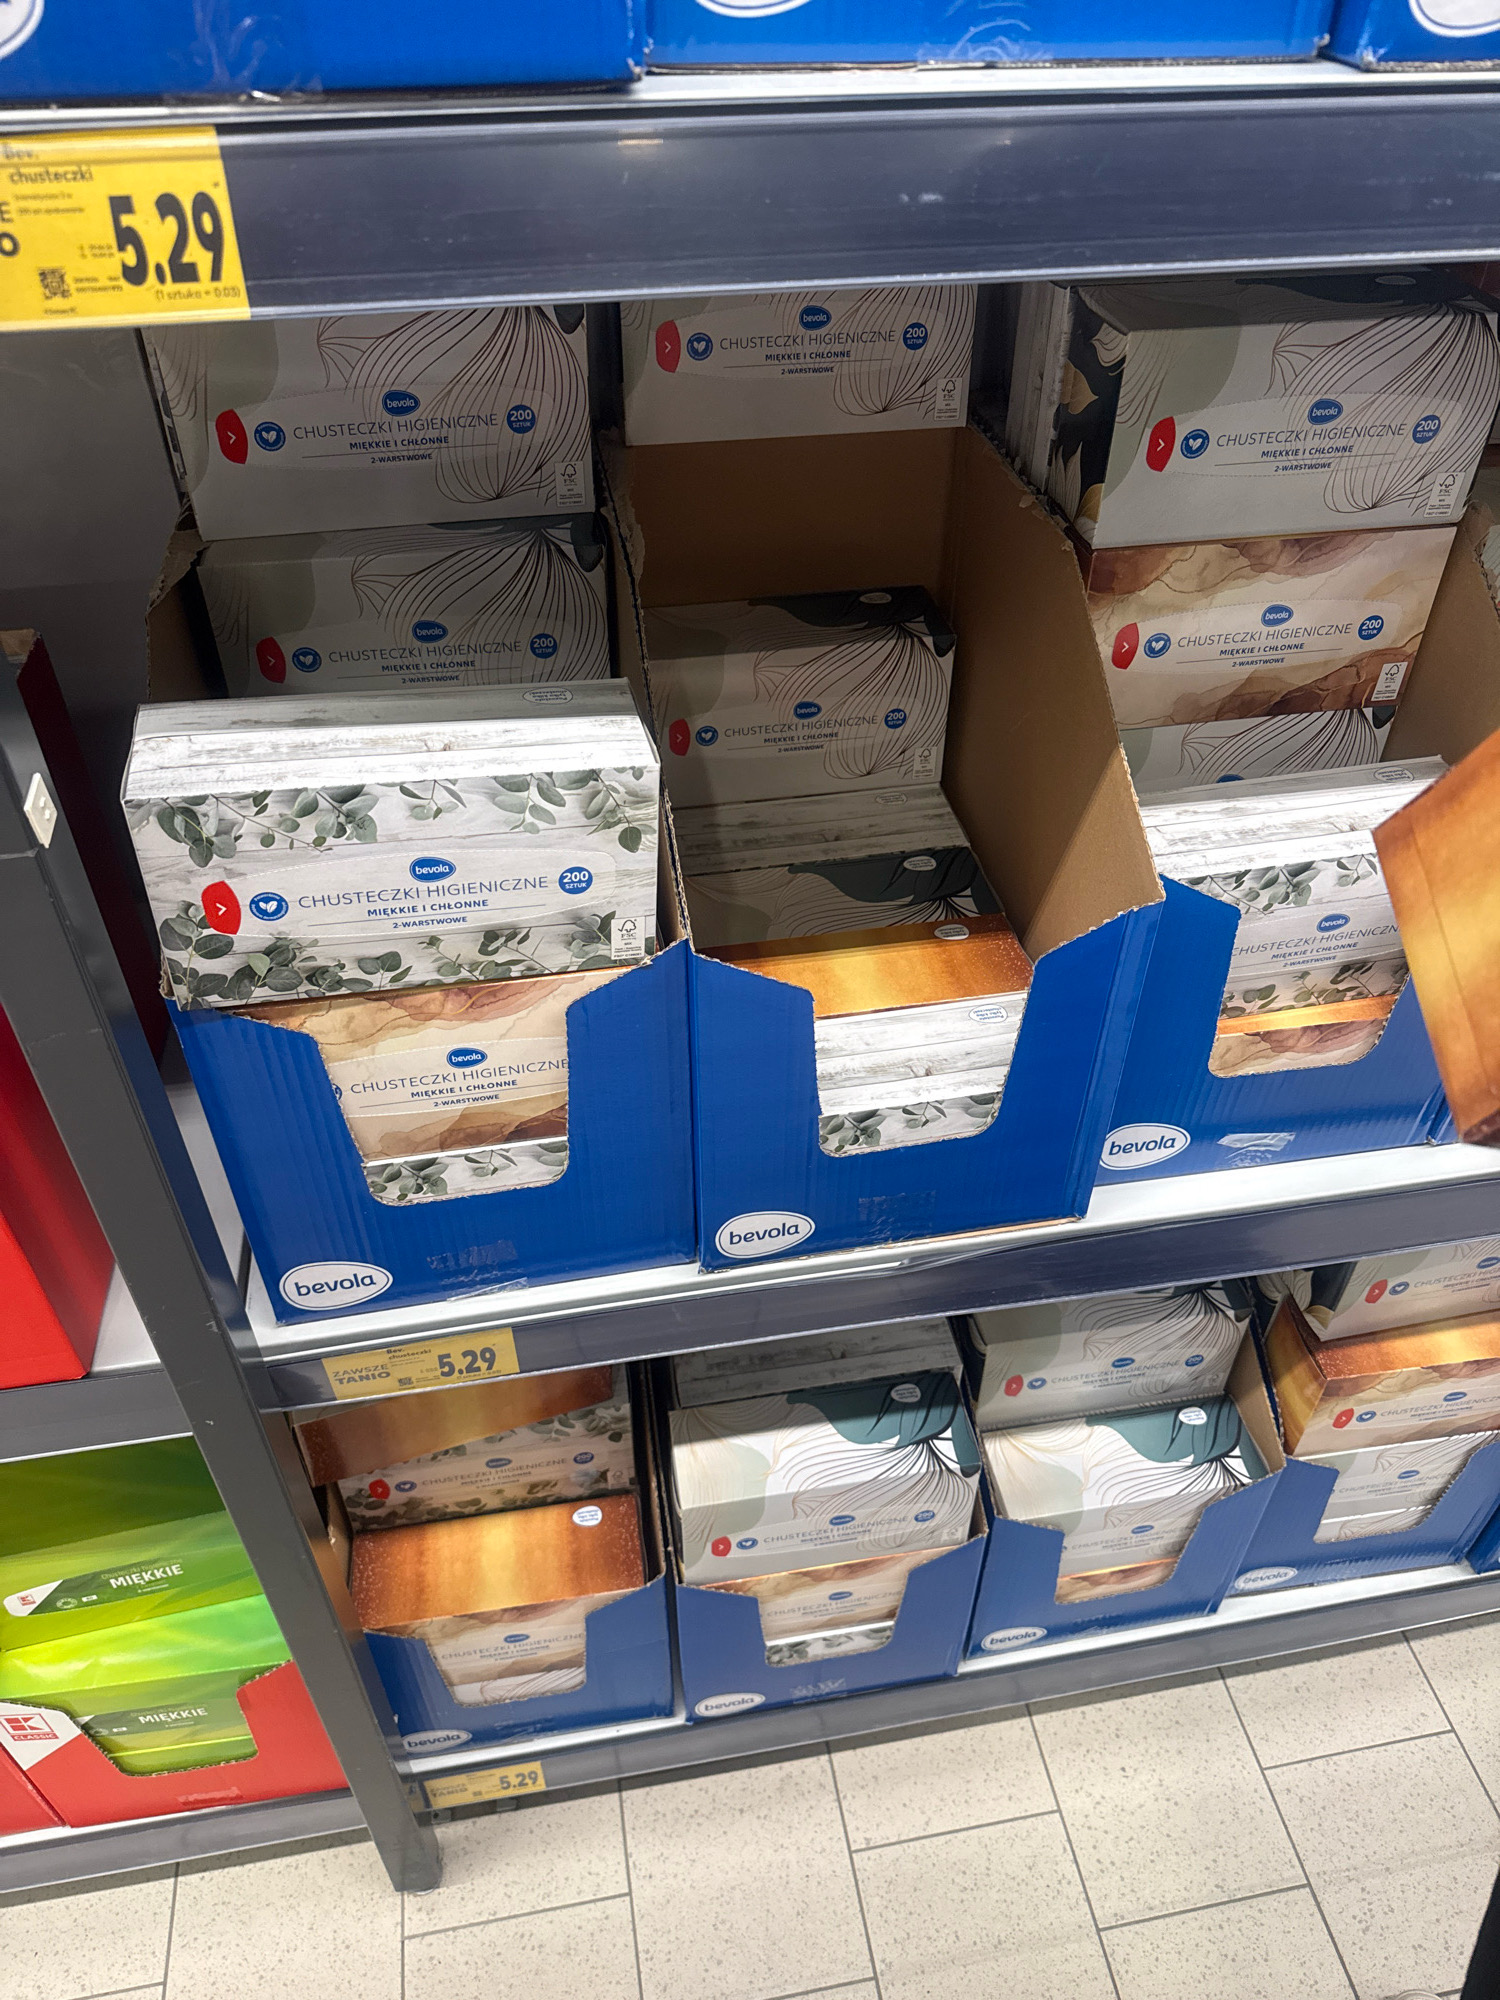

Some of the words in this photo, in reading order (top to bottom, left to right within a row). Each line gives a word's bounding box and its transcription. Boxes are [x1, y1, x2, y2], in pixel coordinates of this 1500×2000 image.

[9, 165, 94, 184] chusteczki
[108, 191, 224, 287] 5.29
[803, 312, 827, 322] bevola
[905, 327, 925, 338] 200
[720, 334, 804, 351] CHUSTECZKI
[808, 330, 896, 345] HIGIENICZNE
[765, 352, 801, 363] MIĘKKIE
[809, 350, 851, 359] CHŁONNE
[780, 366, 834, 375] 2-WARSTWOWE
[386, 398, 416, 408] bevola
[509, 410, 532, 422] 200
[1312, 405, 1339, 417] bevola
[293, 421, 393, 441] CHUSTECZKI
[398, 412, 498, 432] HIGIENICZNE
[512, 421, 531, 429] SZTUK
[1417, 419, 1439, 432] 200
[1216, 429, 1309, 447] CHUSTECZKI
[1312, 423, 1408, 441] HIGIENICZNE
[349, 439, 392, 451] MIĘKKIE
[394, 439, 398, 448] I
[400, 435, 450, 447] CHŁONNE
[370, 453, 433, 464] 2-WARSTWOWE
[1261, 447, 1301, 459] MIĘKKIE
[1308, 445, 1354, 456] CHŁONNE
[1274, 462, 1332, 473] 2-WARSTWOWE
[1264, 609, 1290, 620] bevola
[1361, 618, 1382, 630] 200
[416, 626, 444, 637] bevola
[1177, 630, 1262, 649] CHUSTECZKI
[1266, 622, 1353, 642] HIGIENICZNE
[1361, 629, 1378, 637] SZTUK
[532, 638, 555, 648] 200
[1219, 646, 1255, 658] MIĘKKIE
[1263, 642, 1305, 653] CHŁONNE
[328, 646, 423, 663] CHUSTECZKI
[426, 640, 522, 657] HIGIENICZNE
[381, 662, 422, 673] MIĘKKIE
[430, 659, 476, 670] CHŁONNE
[1231, 657, 1285, 668] 2-WARSTWOWE
[401, 674, 460, 684] 2-WARSTWOWE
[886, 712, 904, 721] 200
[724, 723, 799, 738] CHUSTECZKI
[802, 714, 878, 730] HIGIENICZNE
[764, 736, 795, 744] MIĘKKIE
[802, 732, 838, 741] CHŁONNE
[415, 864, 450, 875] bevola
[563, 871, 589, 883] 200
[299, 887, 420, 909] CHUSTECZKI
[427, 876, 548, 897] HIGIENICZNE
[367, 905, 419, 918] MIĘKKIE
[431, 900, 489, 912] CHŁONNE
[392, 916, 468, 929] 2-WARSTWOWE
[1321, 918, 1345, 929] bevola
[1232, 936, 1316, 957] CHUSTECZKI
[1321, 925, 1399, 945] HIGIENICZN
[1271, 949, 1308, 960] MIĘKKIE
[1315, 942, 1358, 954] CHŁONNE
[1282, 955, 1337, 967] 2-WARSTWOWE
[452, 1053, 481, 1063] bevola
[351, 1074, 457, 1094] CHUSTECZKI
[462, 1059, 568, 1082] HIGIENICZNE
[411, 1086, 456, 1099] MIĘKKIE
[466, 1079, 518, 1092] CHŁONNE
[434, 1094, 499, 1108] 2-WARSTWOWE
[1109, 1136, 1176, 1156] bevola
[729, 1223, 800, 1245] bevola
[294, 1273, 376, 1297] bevola
[437, 1346, 496, 1378] 5.29
[332, 1363, 388, 1378] ZAWSZE
[335, 1371, 391, 1386] TANIO
[422, 1470, 492, 1486] CHUSTECZKI
[496, 1458, 567, 1476] HIGIENICZNE
[763, 1527, 834, 1543] CHUSTECZKI
[109, 1564, 184, 1589] MIĘKKIE
[1242, 1571, 1290, 1584] bevola
[989, 1629, 1037, 1645] bevola
[704, 1696, 755, 1712] bevola
[138, 1707, 208, 1724] MIĘKKIE
[13, 1733, 57, 1741] CLASSIC
[407, 1733, 461, 1748] bevola
[499, 1771, 538, 1790] 5.29
